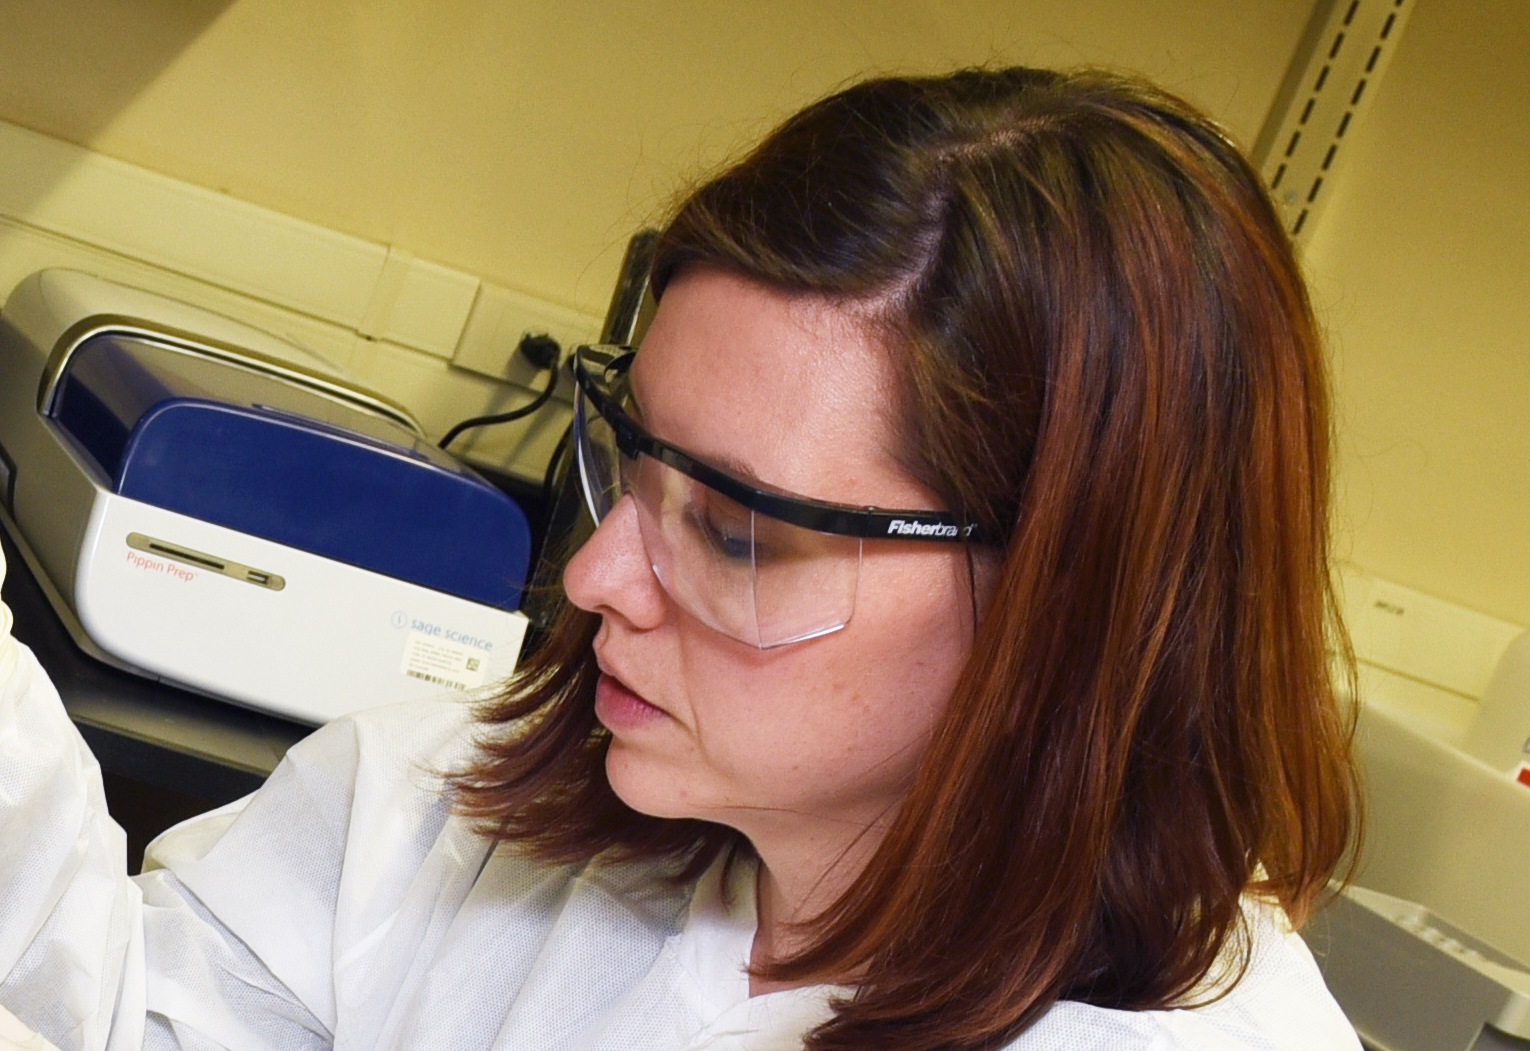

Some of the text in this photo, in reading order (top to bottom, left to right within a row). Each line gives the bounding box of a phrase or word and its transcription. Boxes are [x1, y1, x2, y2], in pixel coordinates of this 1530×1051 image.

[126, 551, 194, 582] Pippin Prep
[410, 619, 442, 636] sage
[445, 628, 494, 652] science
